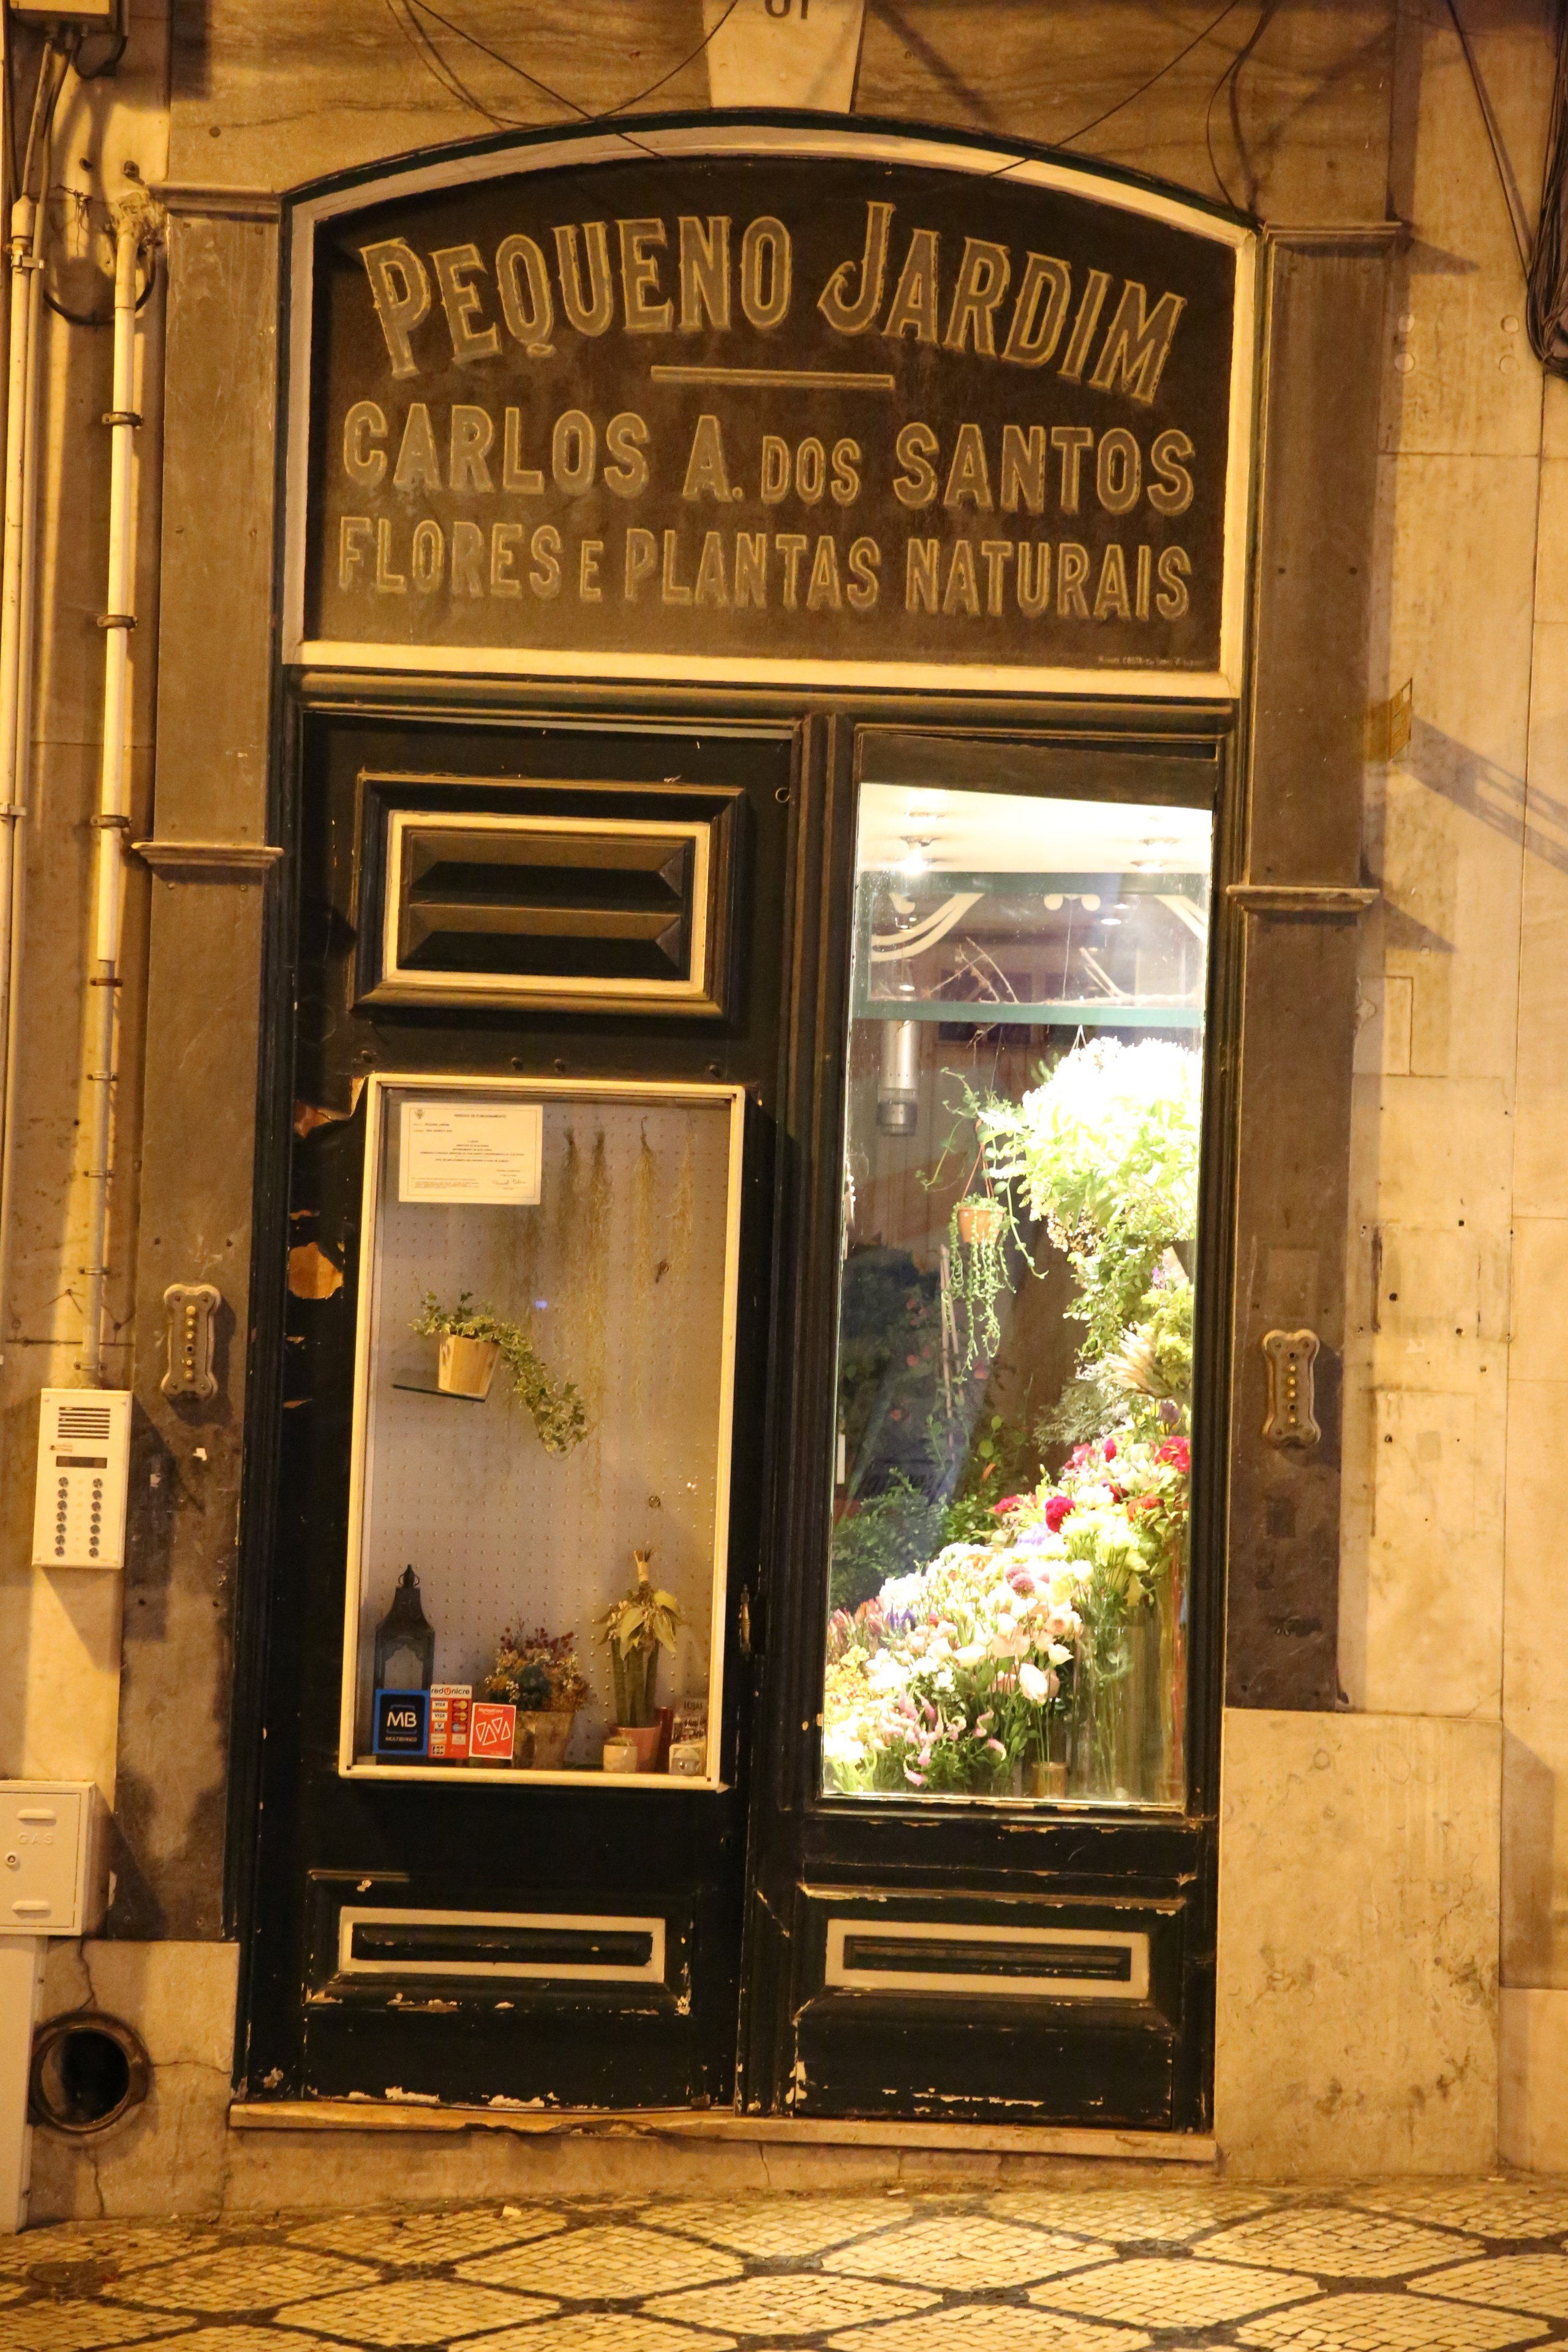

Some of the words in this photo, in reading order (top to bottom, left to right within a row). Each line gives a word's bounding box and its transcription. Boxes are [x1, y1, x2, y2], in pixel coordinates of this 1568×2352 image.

[360, 216, 792, 379] PEQUENO
[818, 201, 1188, 405] JARDIM
[343, 401, 649, 498] CARLOS
[683, 414, 743, 503] A.
[761, 435, 862, 506] DOS
[894, 422, 1195, 517] SANTOS
[338, 517, 562, 600] FLORES
[580, 540, 604, 603] E
[625, 529, 881, 610] PLANTAS
[906, 538, 1191, 622] NATURAIS
[386, 1711, 417, 1727] MB
